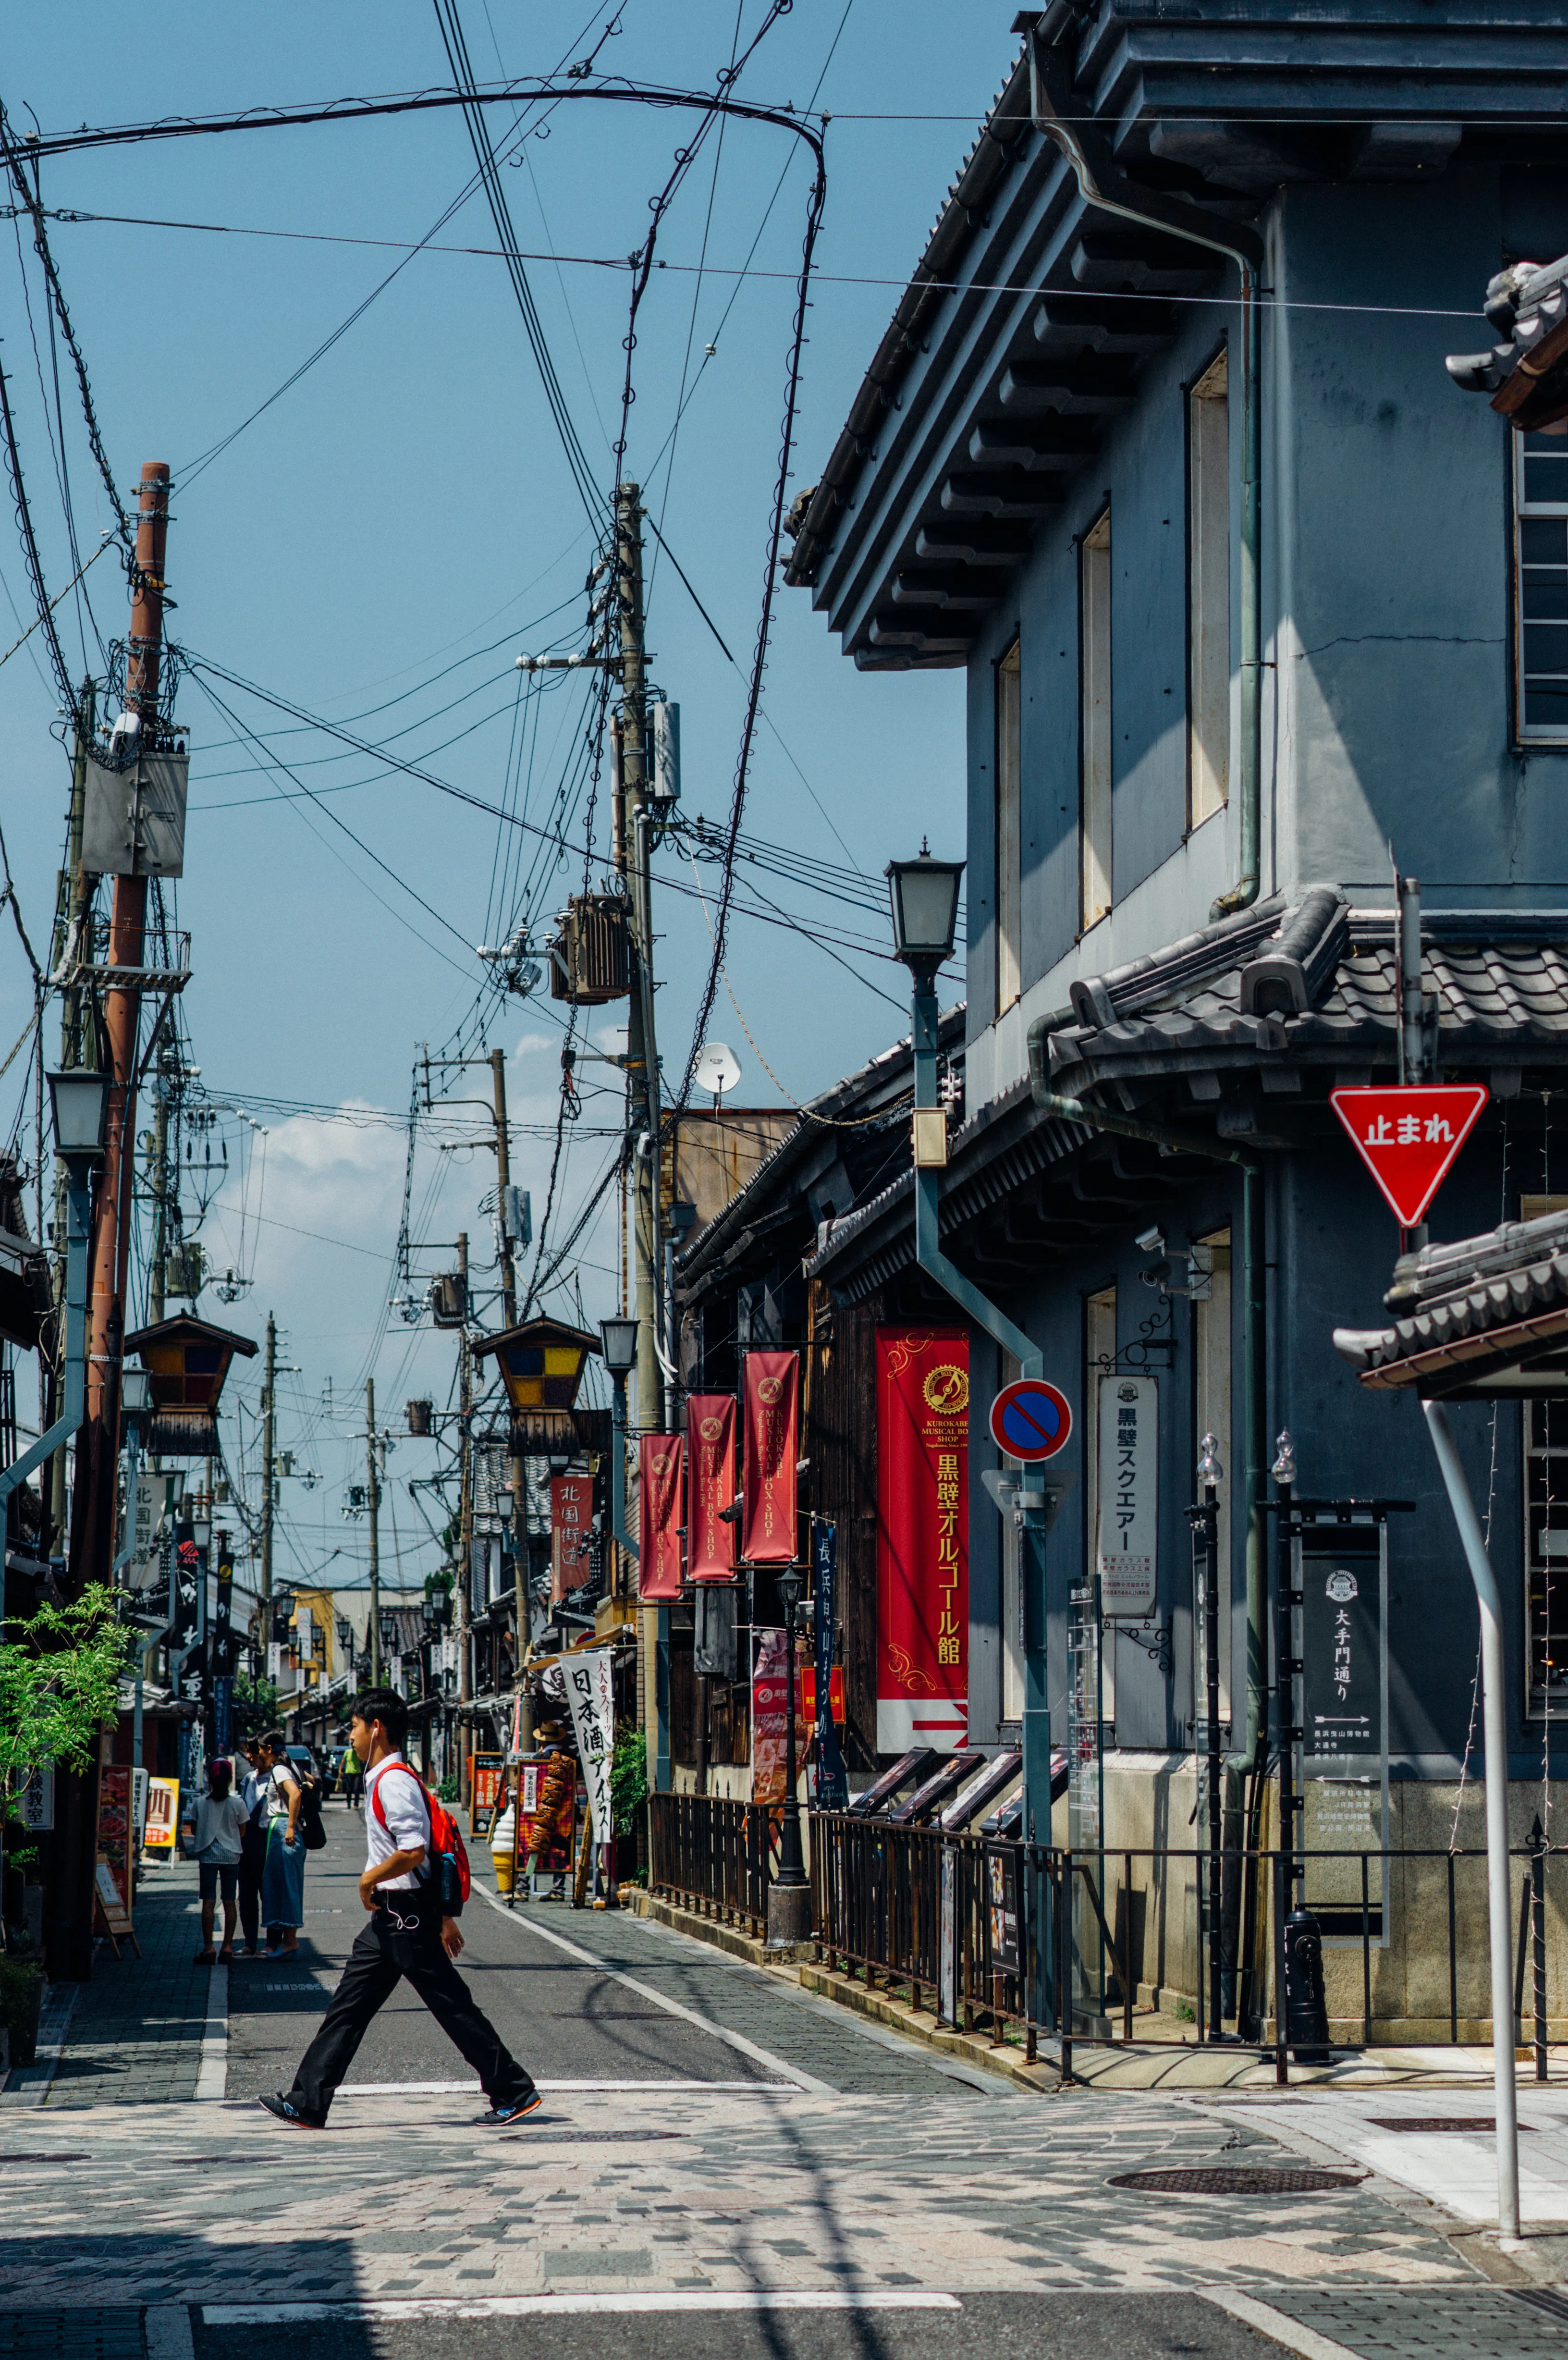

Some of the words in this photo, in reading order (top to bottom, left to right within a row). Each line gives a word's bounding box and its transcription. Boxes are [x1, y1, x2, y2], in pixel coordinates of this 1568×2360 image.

[1364, 1113, 1455, 1145] 止まれ
[707, 1446, 715, 1500] MUSICAL
[765, 1410, 774, 1470] MUSICAL
[776, 1410, 784, 1478] KUROKABE
[764, 1474, 773, 1500] BOX
[1116, 1408, 1137, 1550] 黒壁スクエアー
[131, 1487, 152, 1565] 北国街道
[560, 1485, 581, 1566] 北国街道
[707, 1528, 715, 1559] SHOP
[764, 1503, 773, 1537] SHOP
[937, 1454, 960, 1665] 黒壁オルゴール館
[1334, 1609, 1351, 1702] 大手門通り
[597, 1660, 612, 1734] 大人のスイーツ
[572, 1668, 608, 1827] 日本酒アイス
